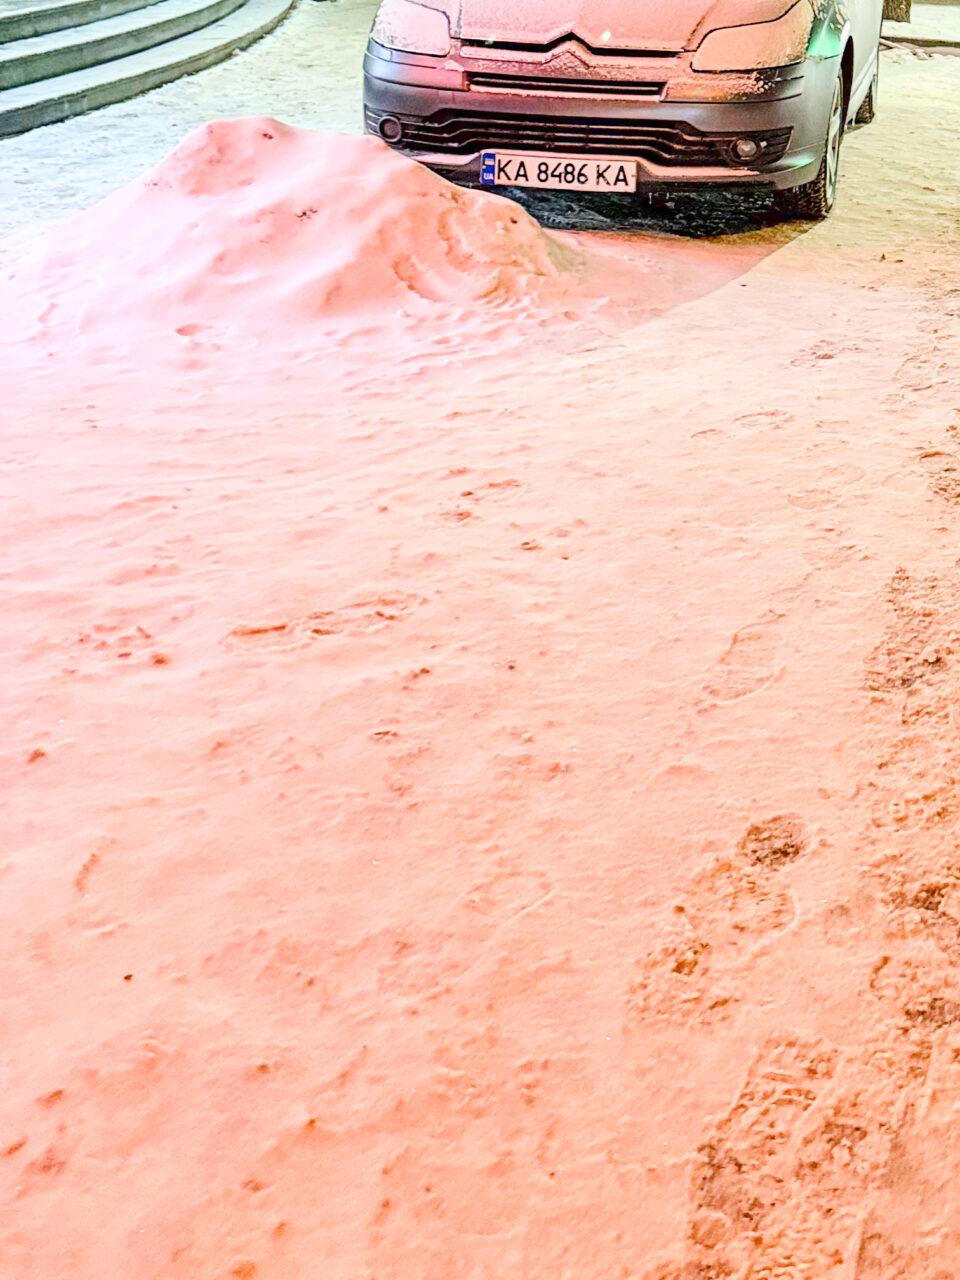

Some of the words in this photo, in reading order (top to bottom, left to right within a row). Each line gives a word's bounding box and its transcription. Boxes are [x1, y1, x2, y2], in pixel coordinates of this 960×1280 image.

[497, 159, 529, 182] KA
[537, 162, 588, 185] 8486
[596, 165, 629, 187] KA
